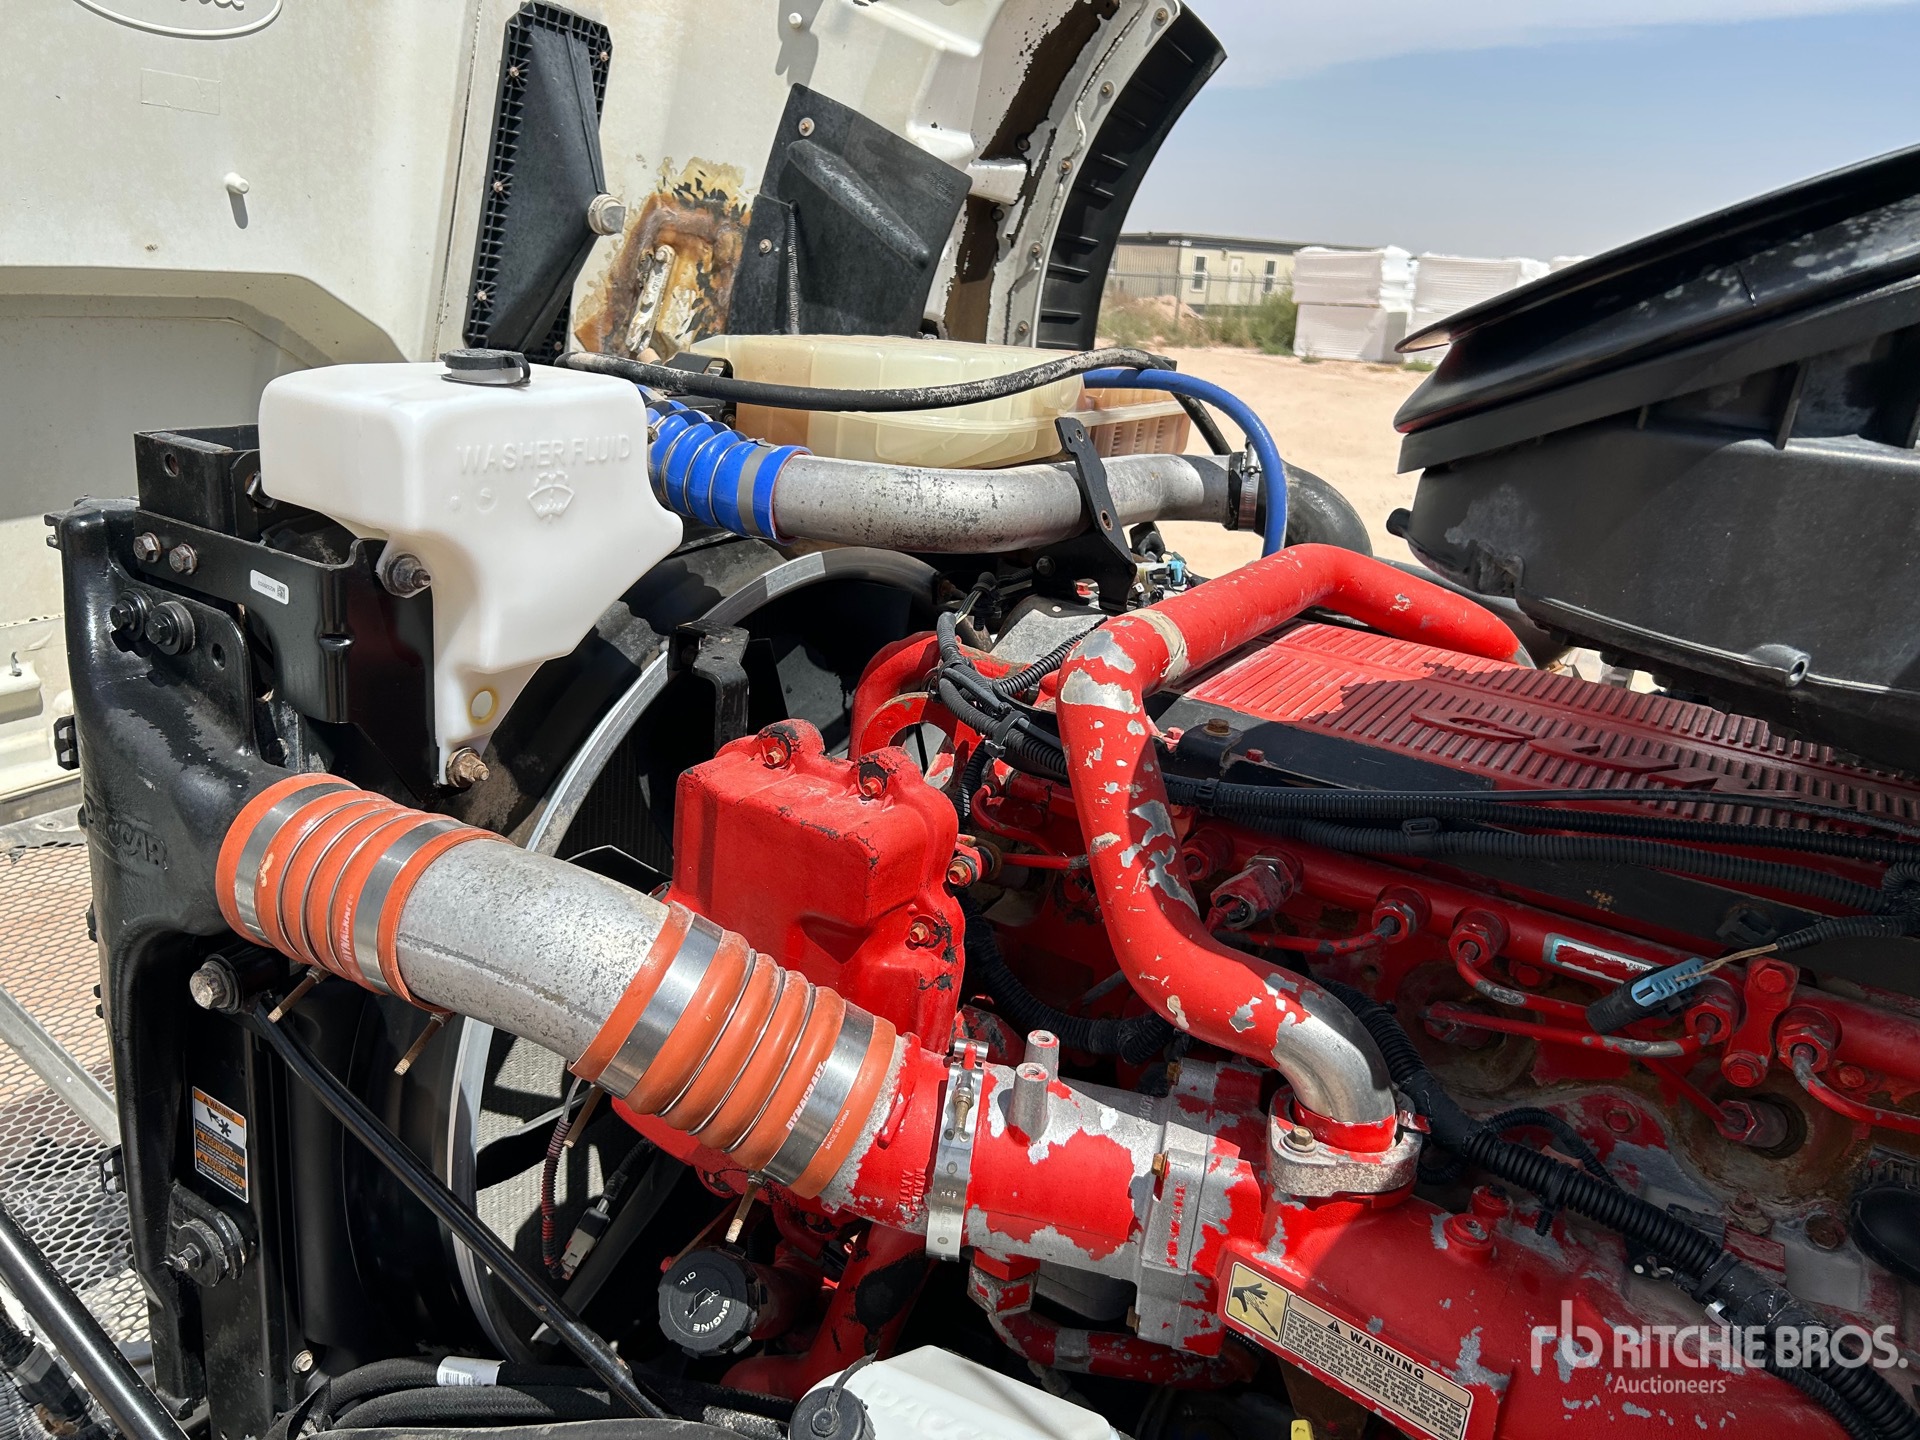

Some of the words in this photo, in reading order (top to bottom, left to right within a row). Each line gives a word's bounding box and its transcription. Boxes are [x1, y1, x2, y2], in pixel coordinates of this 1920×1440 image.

[457, 440, 566, 474] WASHER
[571, 433, 631, 466] FLUID
[679, 1271, 697, 1286] OIL
[692, 1300, 730, 1333] ENGINE
[1350, 1331, 1424, 1380] WARNING
